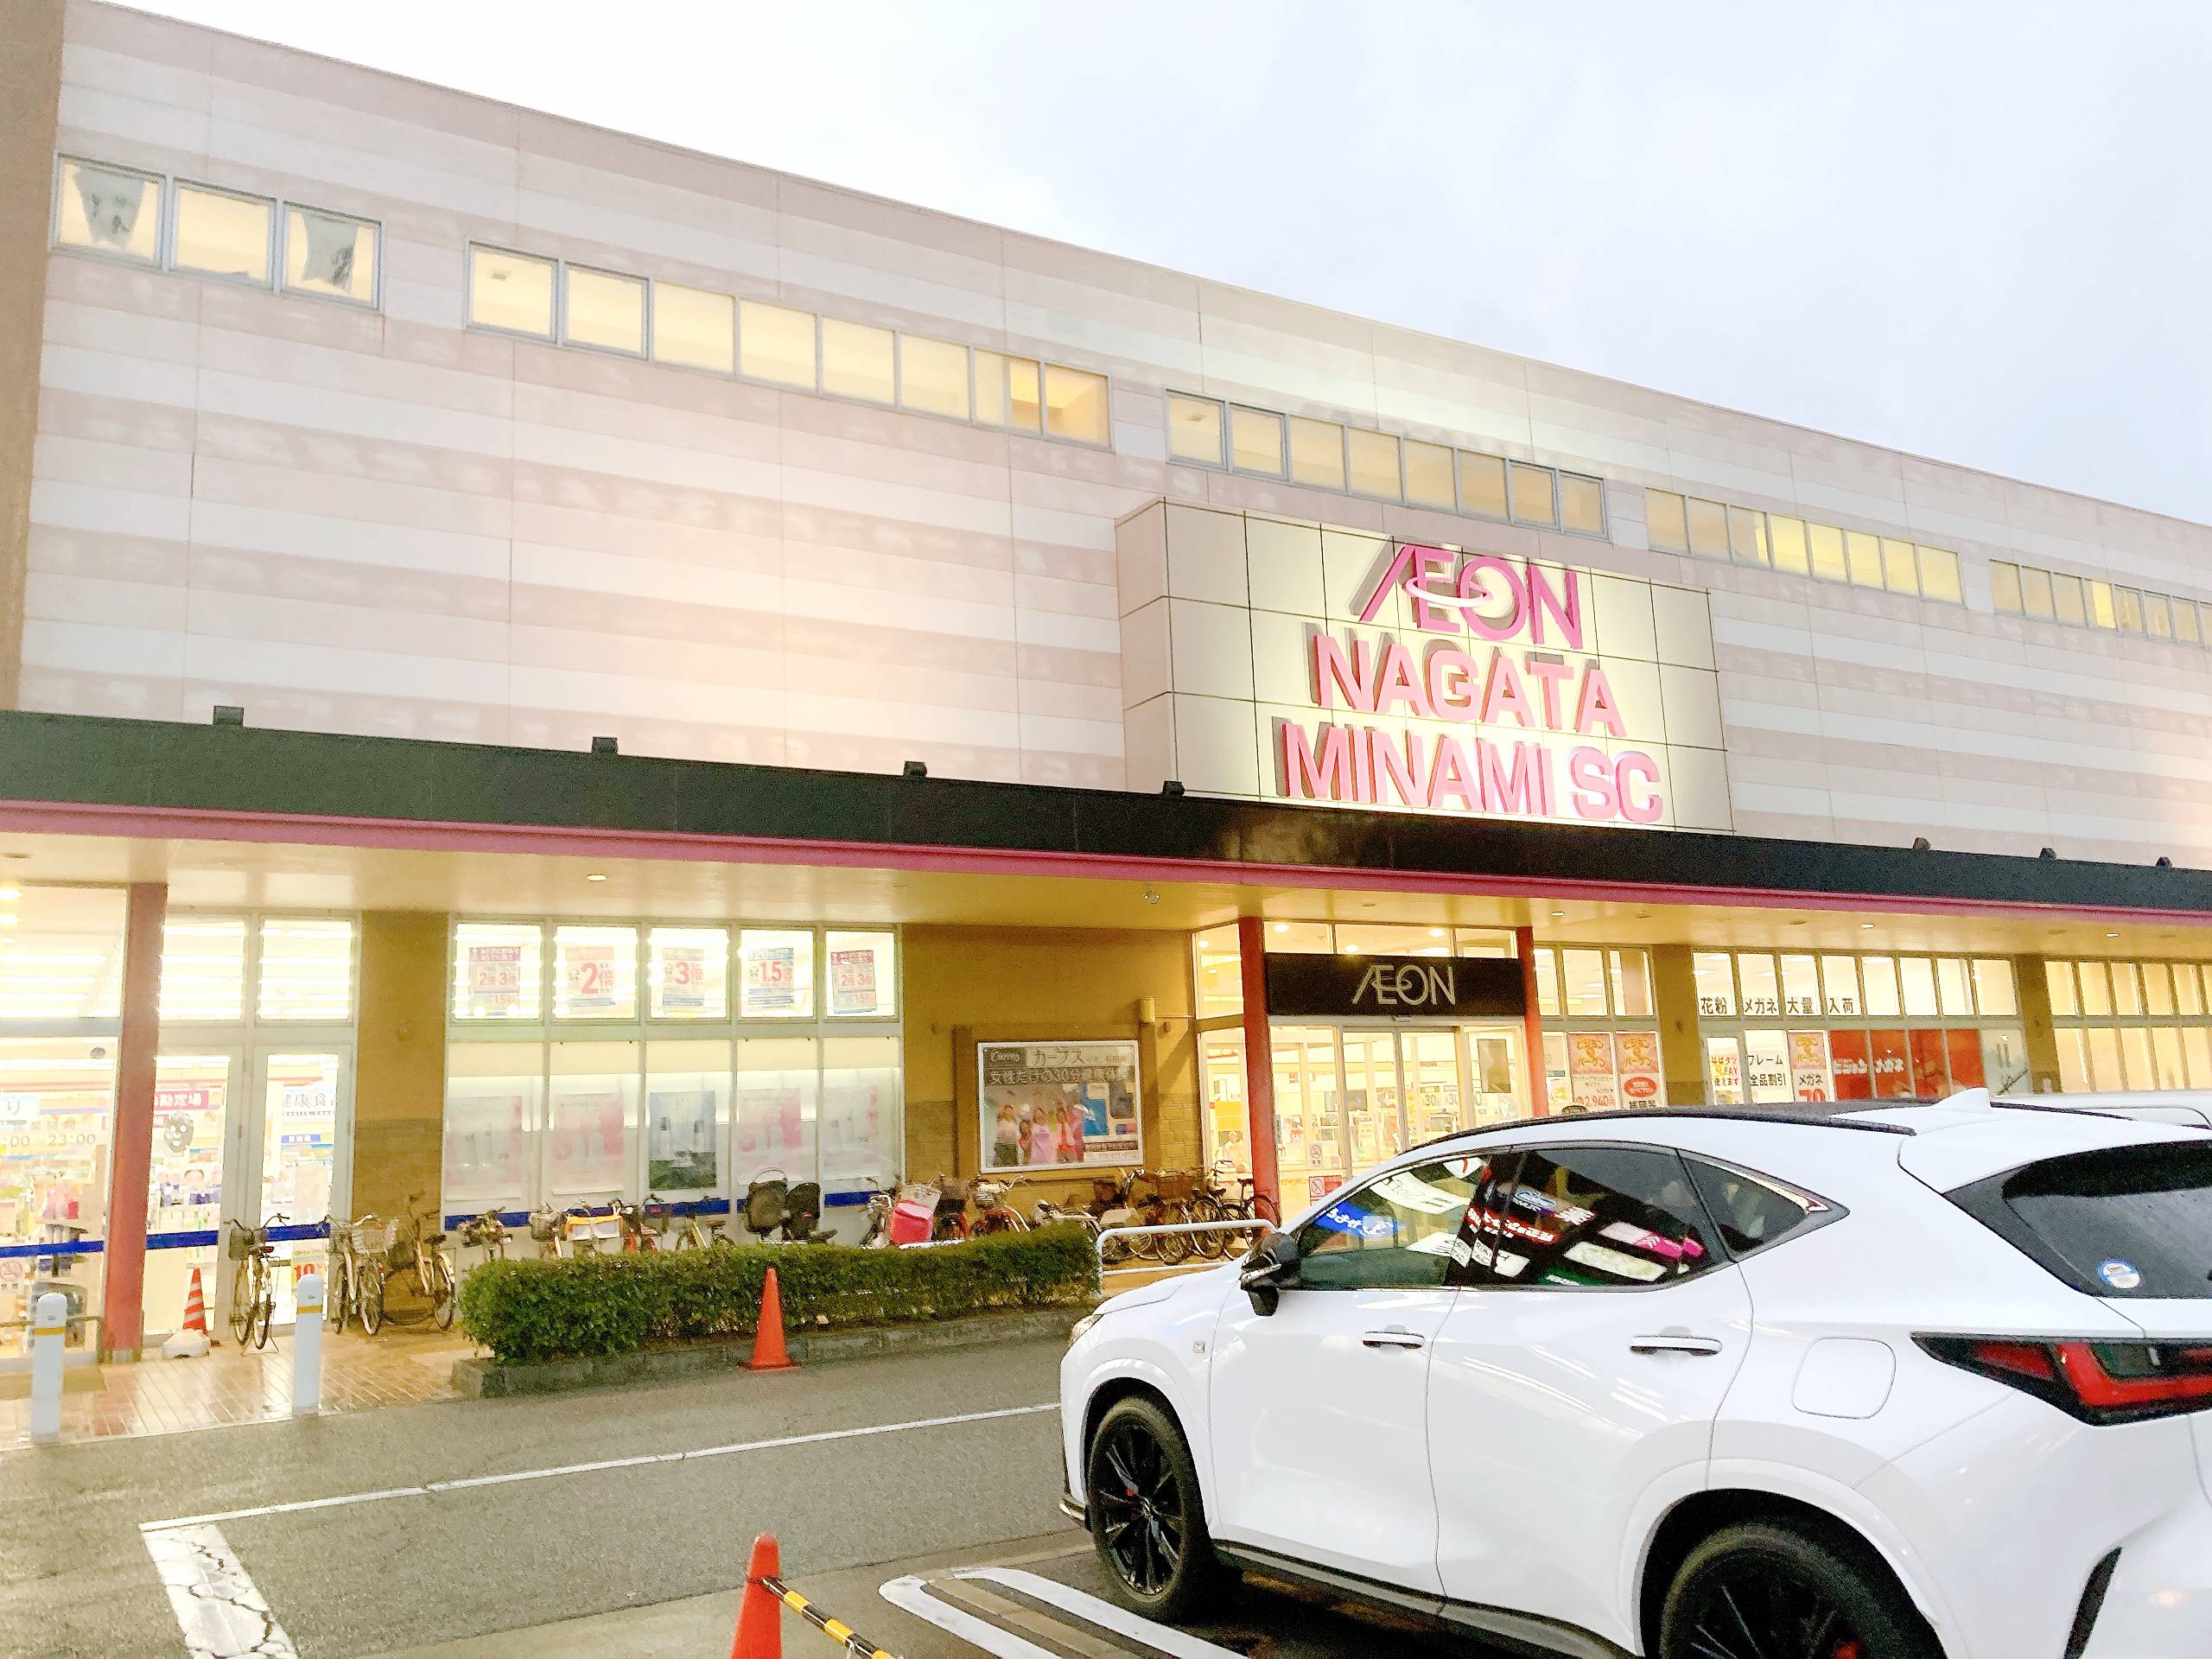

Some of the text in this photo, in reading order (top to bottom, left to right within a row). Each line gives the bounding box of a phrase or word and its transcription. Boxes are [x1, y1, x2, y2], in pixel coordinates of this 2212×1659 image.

[1313, 634, 1628, 738] NAGATA
[1282, 721, 1664, 824] MINAMI SC
[1700, 996, 1854, 1014] 花粉 メガネ 大量 入荷
[1747, 1053, 1783, 1065] フレーム
[1750, 1073, 1786, 1087] 全品割引
[1799, 1075, 1823, 1087] メガネ
